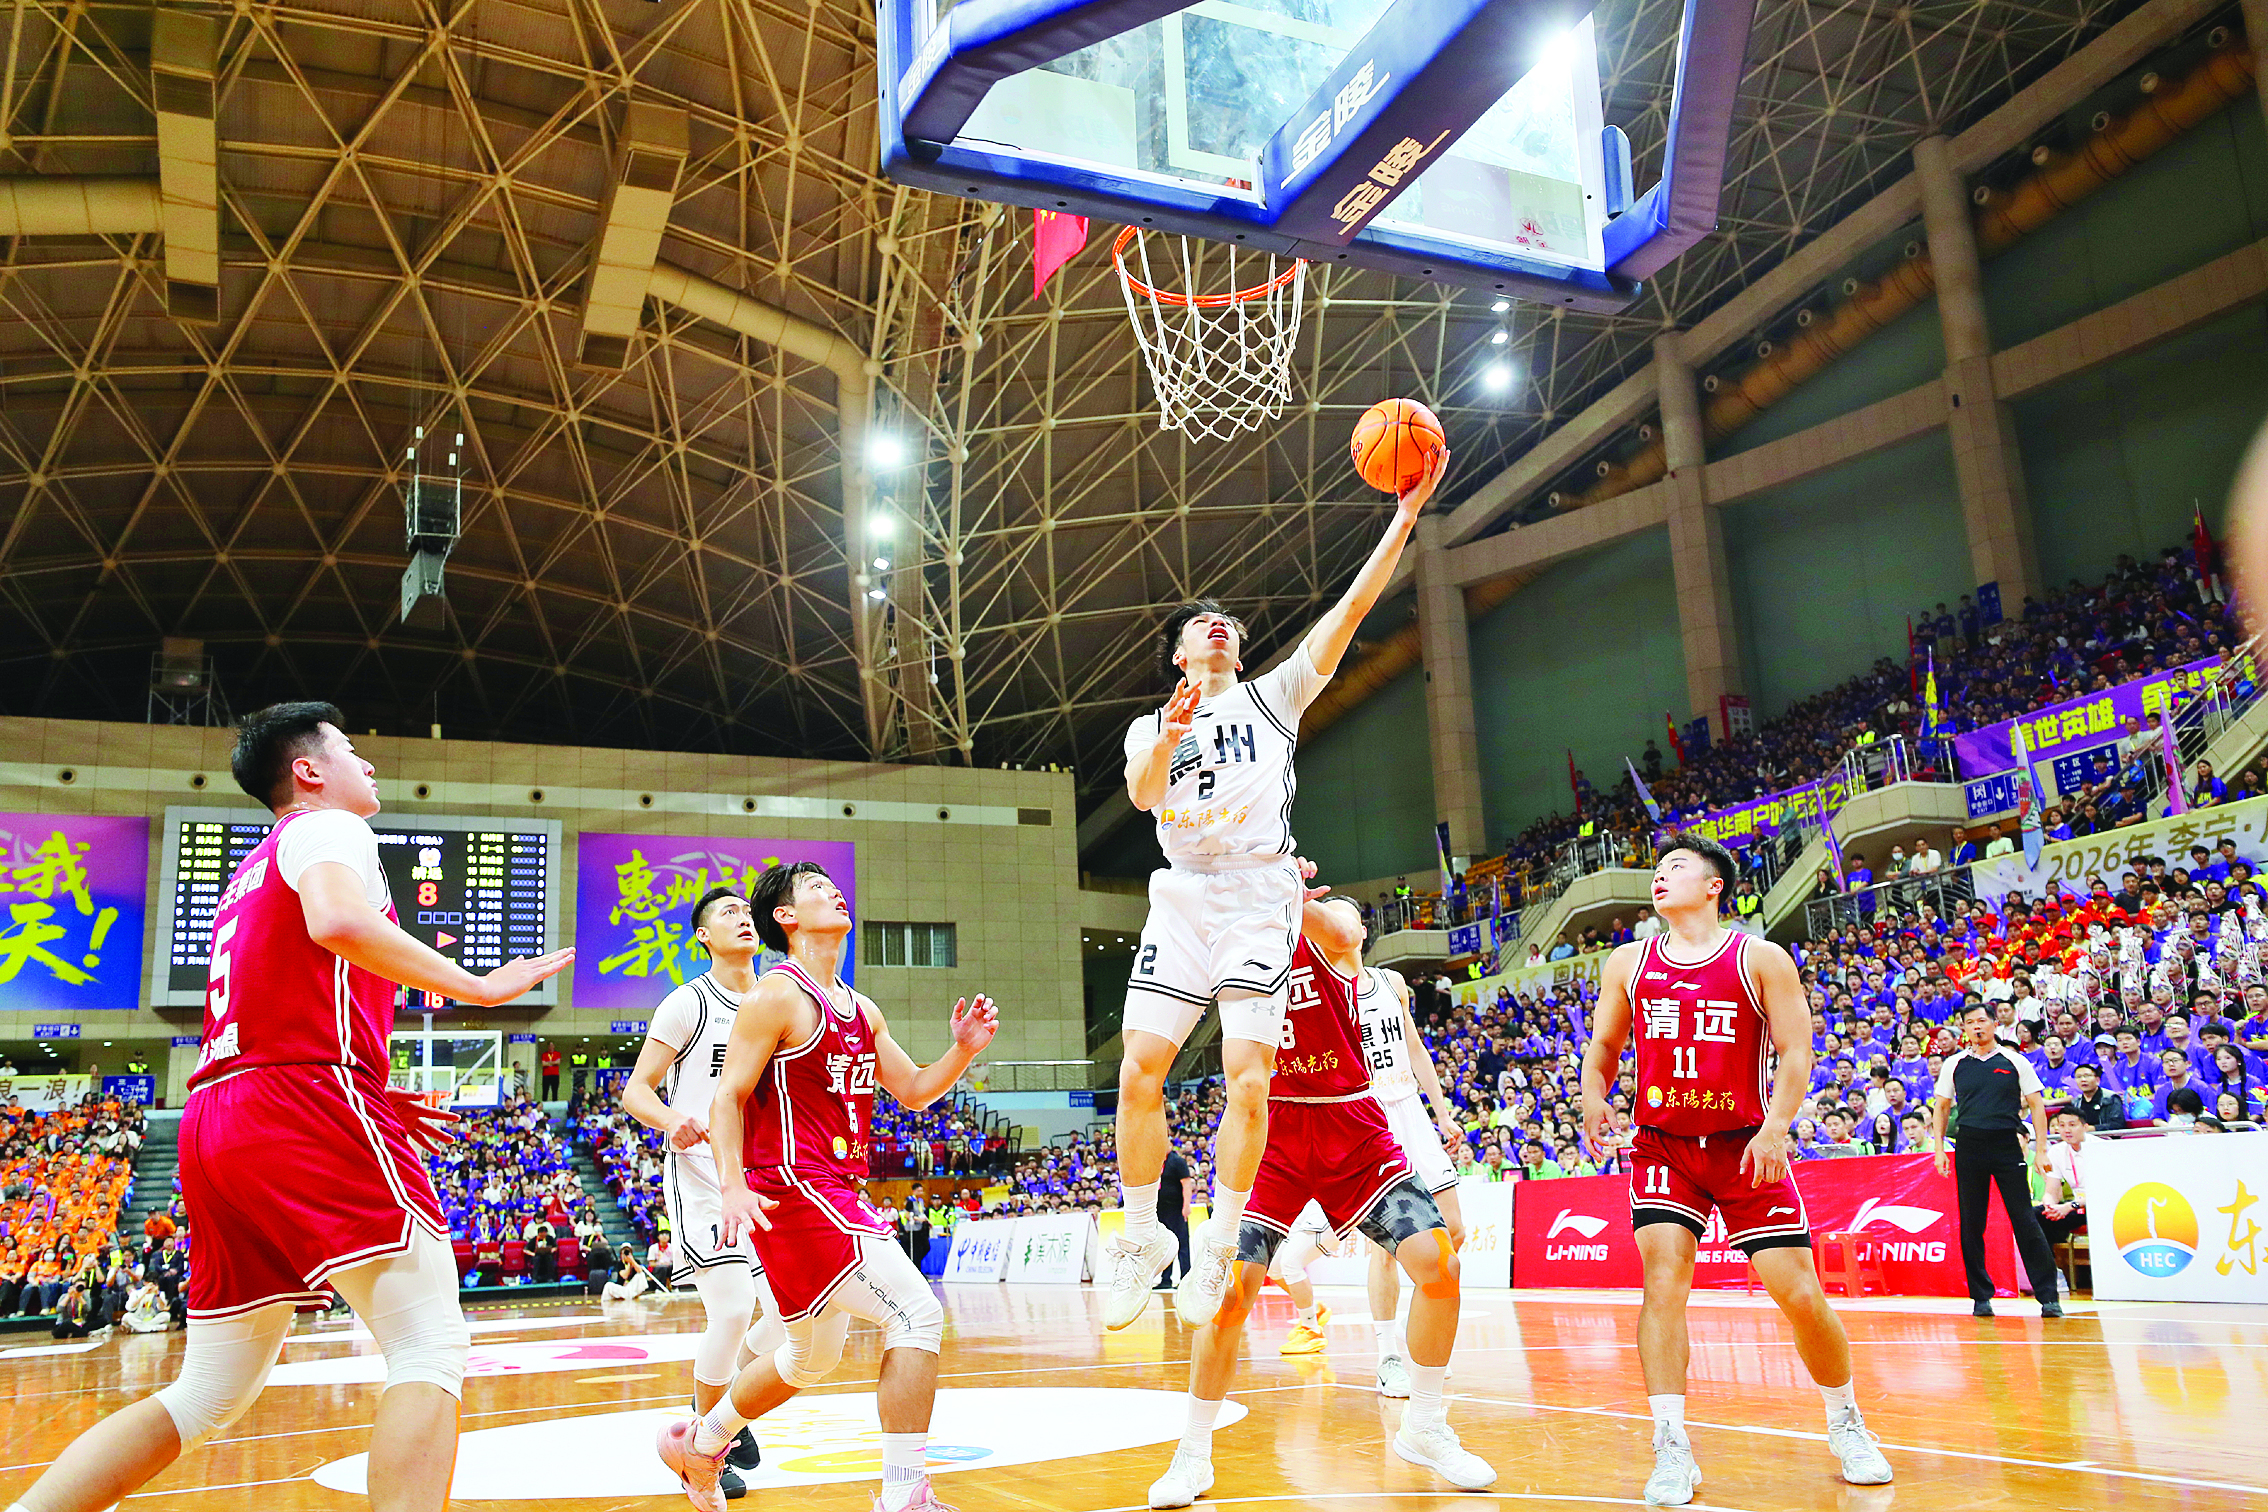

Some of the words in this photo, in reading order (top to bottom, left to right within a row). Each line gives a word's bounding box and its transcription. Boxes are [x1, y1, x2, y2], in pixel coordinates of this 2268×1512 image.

[1280, 58, 1391, 190] 金陵
[1330, 129, 1451, 236] 金陵
[1198, 770, 1215, 801] 2
[417, 881, 439, 907] 8
[210, 915, 239, 1022] 5
[1140, 944, 1158, 976] 2
[1640, 997, 1738, 1044] 清远
[825, 1052, 876, 1095] 清远
[1372, 1049, 1394, 1070] 25
[1672, 1046, 1699, 1079] 11
[1644, 1165, 1671, 1195] 11
[1546, 1244, 1609, 1261] LI-NING
[2140, 1253, 2176, 1268] HEC
[869, 1281, 899, 1312] YOUR
